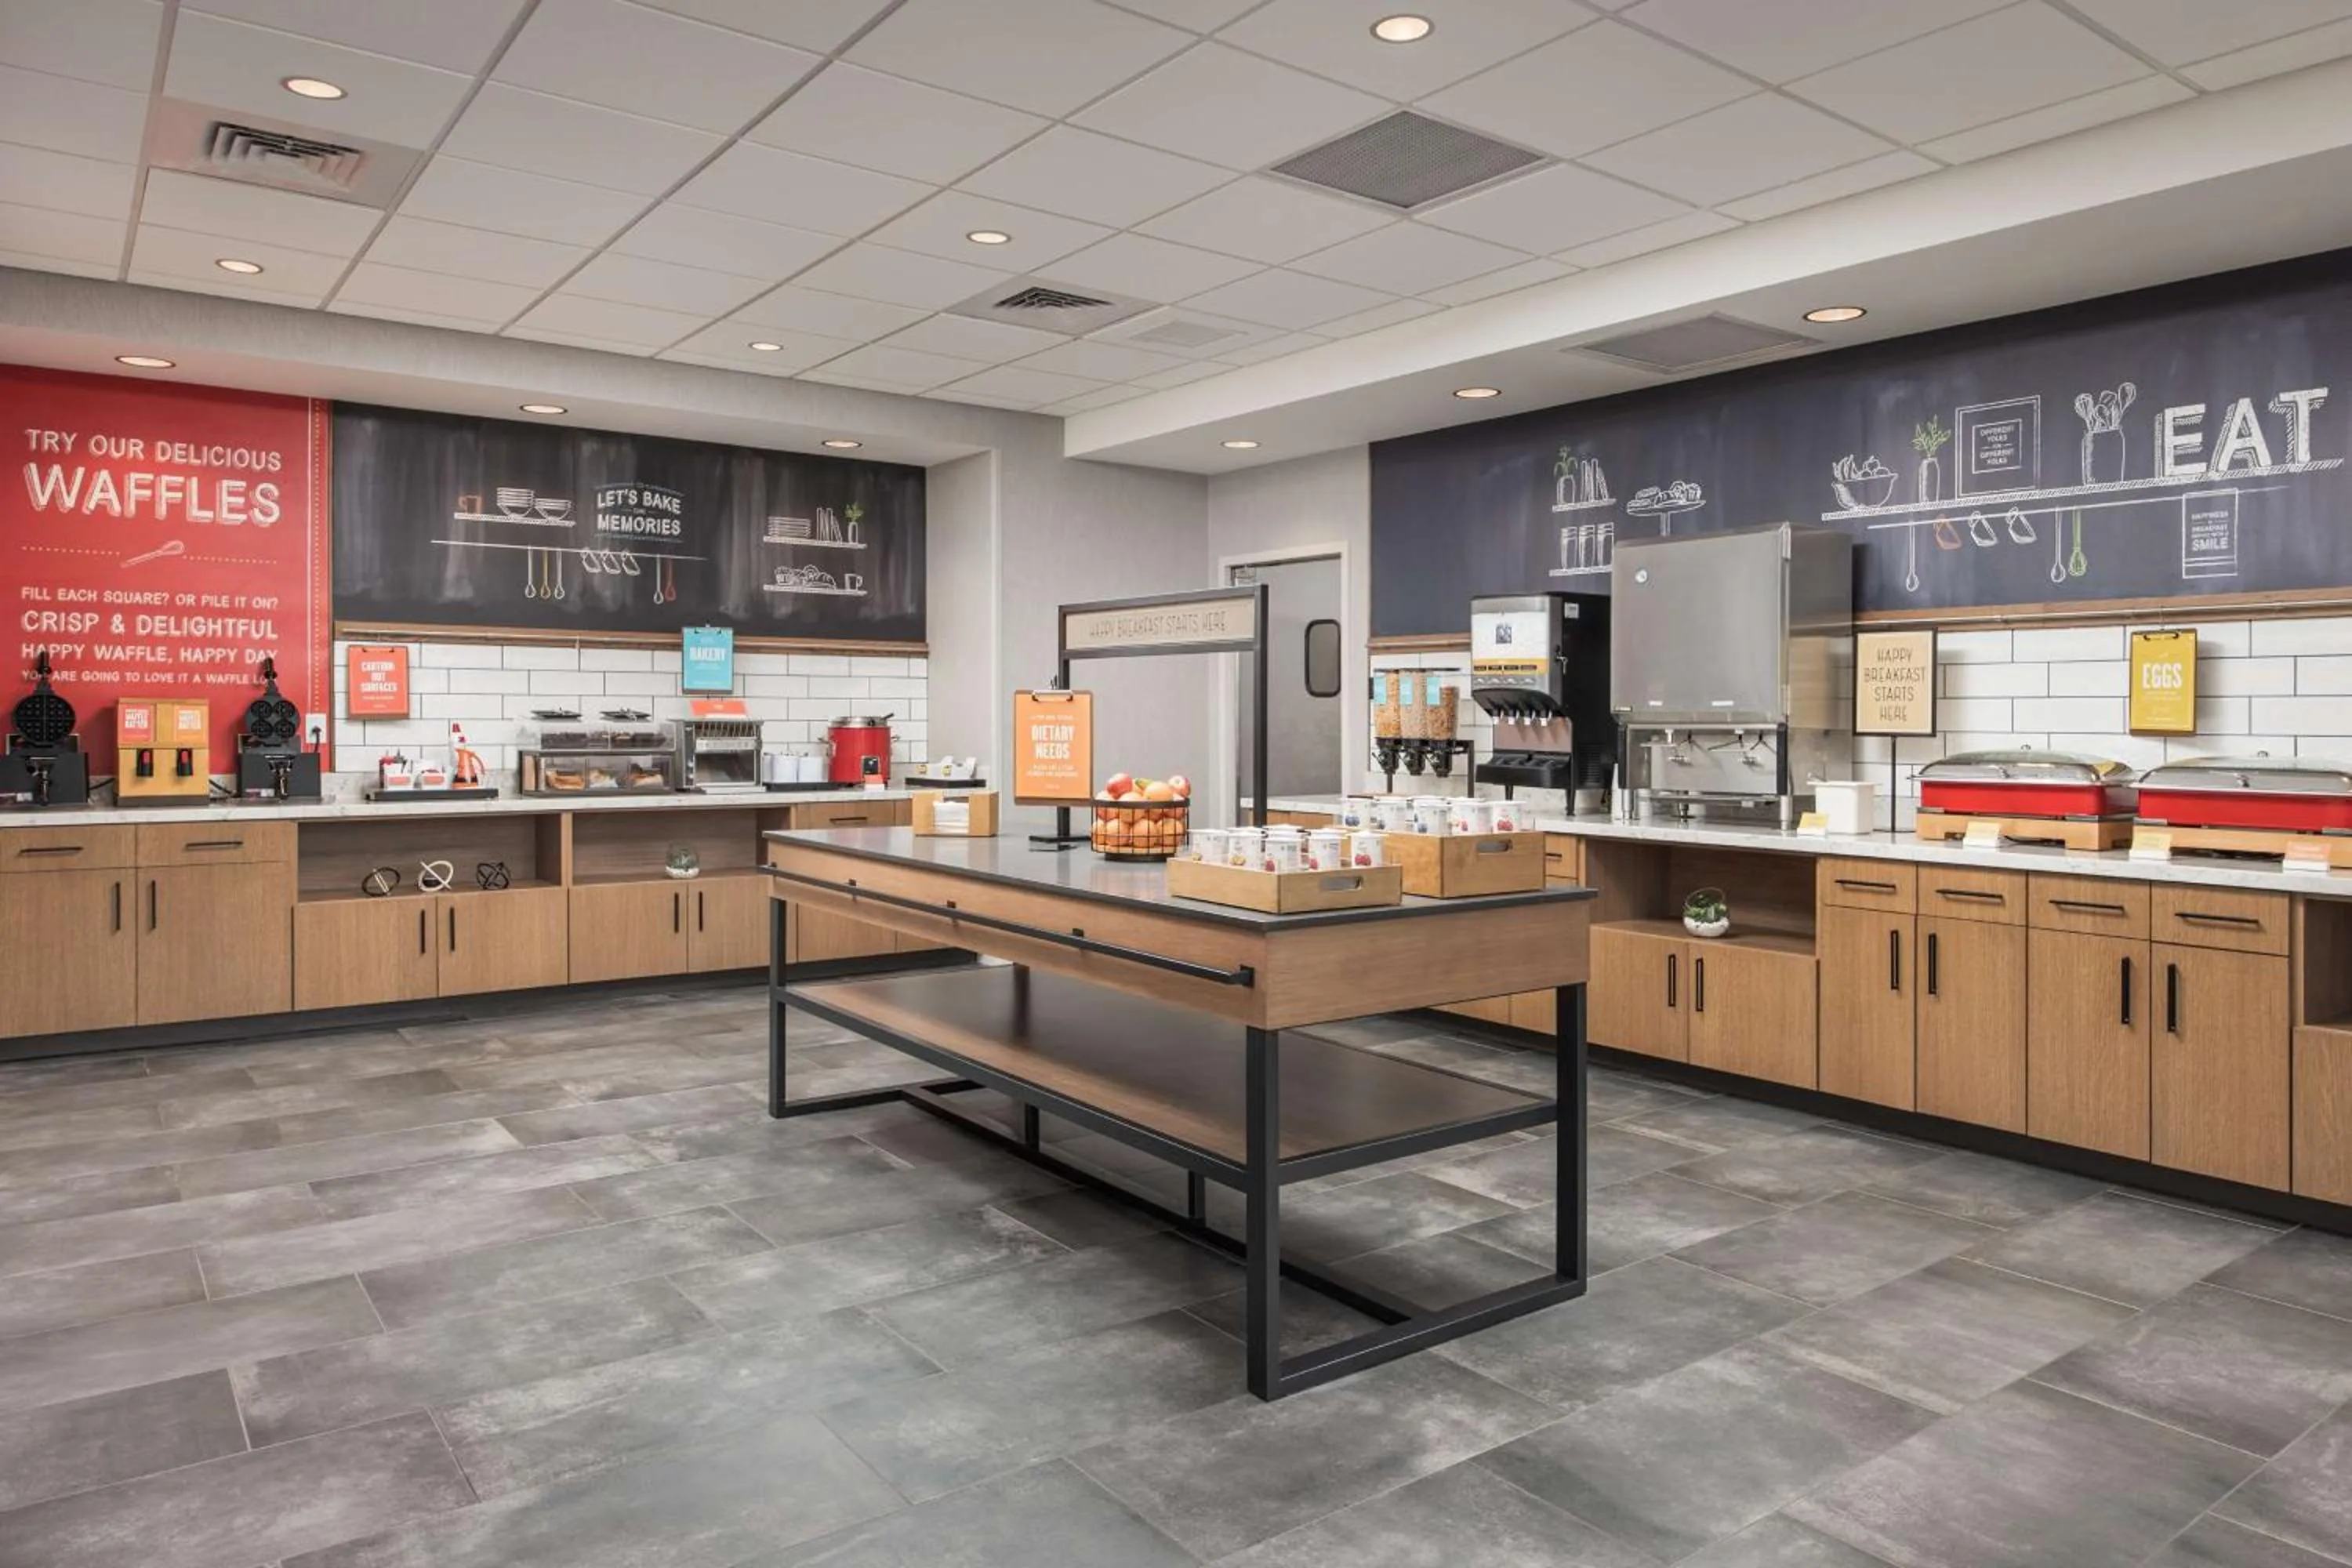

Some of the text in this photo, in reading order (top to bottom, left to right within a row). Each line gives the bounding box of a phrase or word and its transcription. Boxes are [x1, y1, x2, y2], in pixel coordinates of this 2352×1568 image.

[2154, 387, 2329, 479] EAT
[25, 429, 282, 472] TRY OUR DELICIOUS
[24, 463, 281, 527] WAFFLES
[597, 488, 681, 515] LET'S BAKE
[597, 514, 682, 536] MEMORIES
[2192, 537, 2229, 551] SMILE
[22, 586, 279, 610] FILL EACH SQUARE? OR PILE IT ON?
[22, 610, 278, 641] CRISP & DELIGHTFUL
[22, 643, 278, 665] HAPPY WAFFLE, HAPPY DAY
[1877, 647, 1913, 663] HAPPY
[52, 670, 78, 682] ARE
[81, 671, 121, 683] GOING
[125, 672, 140, 683] TO
[143, 673, 175, 684] LOVE
[178, 673, 190, 684] IT
[192, 673, 201, 684] A
[206, 673, 249, 685] WAFFLE
[1863, 666, 1926, 684] BREAKFAST
[2142, 662, 2183, 689] EGGS
[1875, 685, 1915, 702] STARTS
[1879, 706, 1907, 722] HERE
[1031, 724, 1076, 742] DIETARY
[1035, 742, 1072, 760] NEEDS
